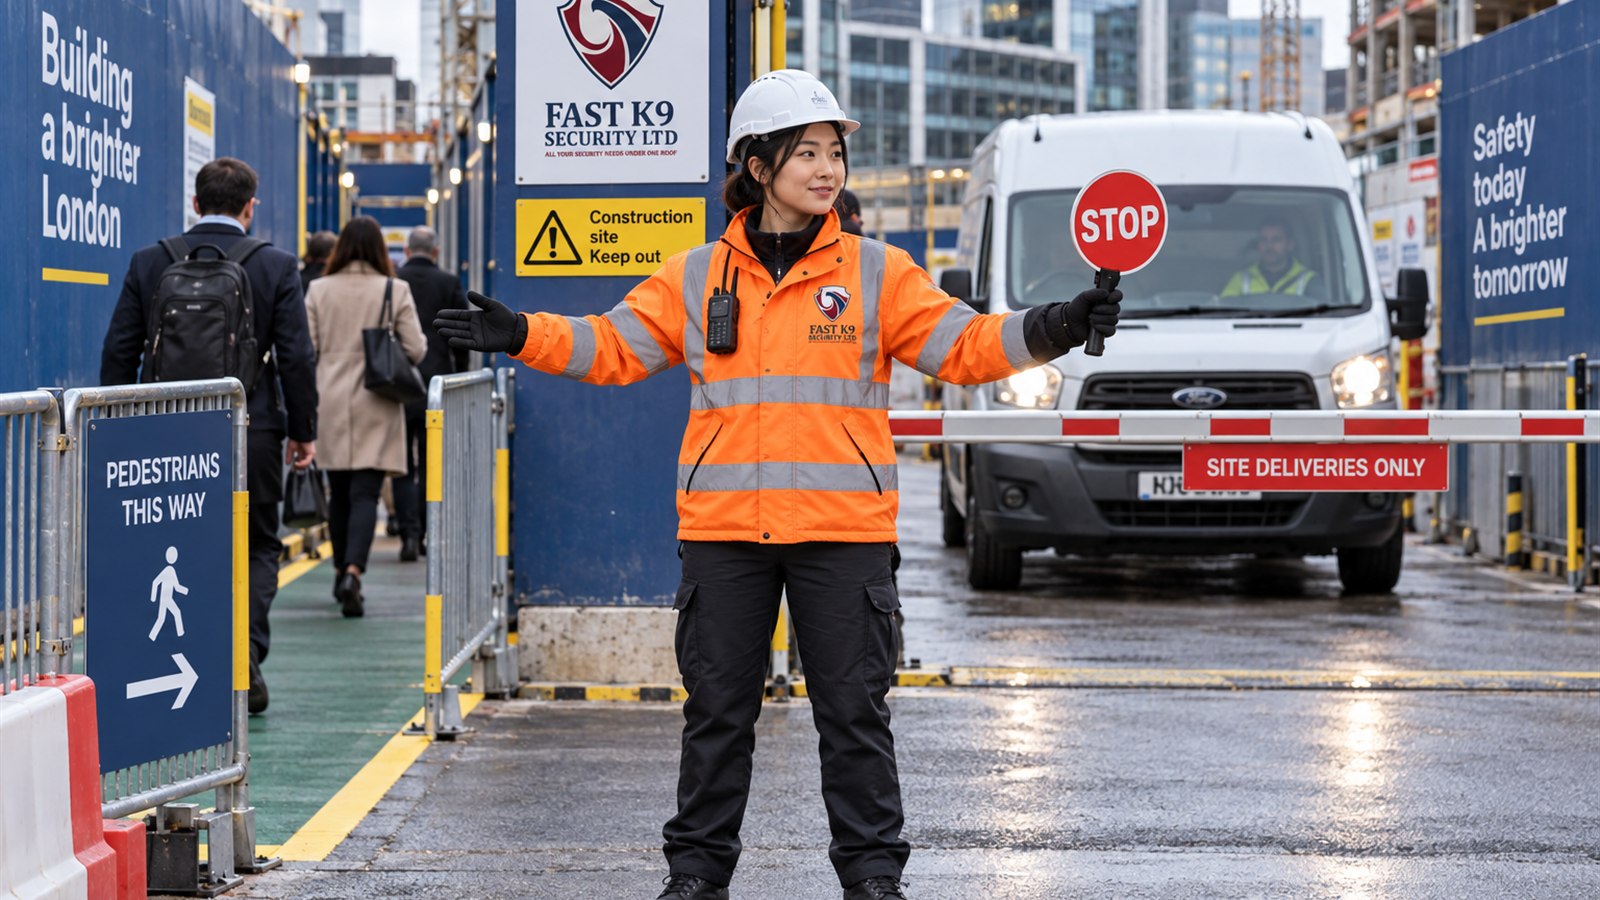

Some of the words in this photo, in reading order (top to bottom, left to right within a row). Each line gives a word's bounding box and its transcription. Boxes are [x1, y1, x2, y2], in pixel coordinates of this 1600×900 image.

[42, 11, 133, 129] Building
[545, 101, 624, 128] FAST
[631, 100, 675, 127] K9
[42, 112, 55, 161] a
[62, 103, 141, 188] brighter
[544, 130, 637, 147] SECURITY
[642, 130, 678, 146] LTD
[1473, 112, 1536, 161] Safety
[1473, 163, 1526, 207] today
[42, 174, 122, 248] London
[590, 210, 693, 225] Construction
[1081, 204, 1160, 243] STOP
[590, 230, 619, 244] site
[1472, 217, 1487, 254] A
[1490, 204, 1567, 256] brighter
[590, 249, 630, 266] Keep
[635, 252, 661, 264] out
[1473, 256, 1568, 300] tomorrow
[809, 324, 838, 334] FAST
[840, 324, 855, 334] K9
[106, 452, 221, 488] PEDESTRIANS
[1206, 458, 1250, 477] SITE
[1256, 458, 1369, 477] DELIVERIES
[1374, 458, 1426, 477] ONLY
[122, 496, 163, 526] THIS
[168, 492, 206, 520] WAY
